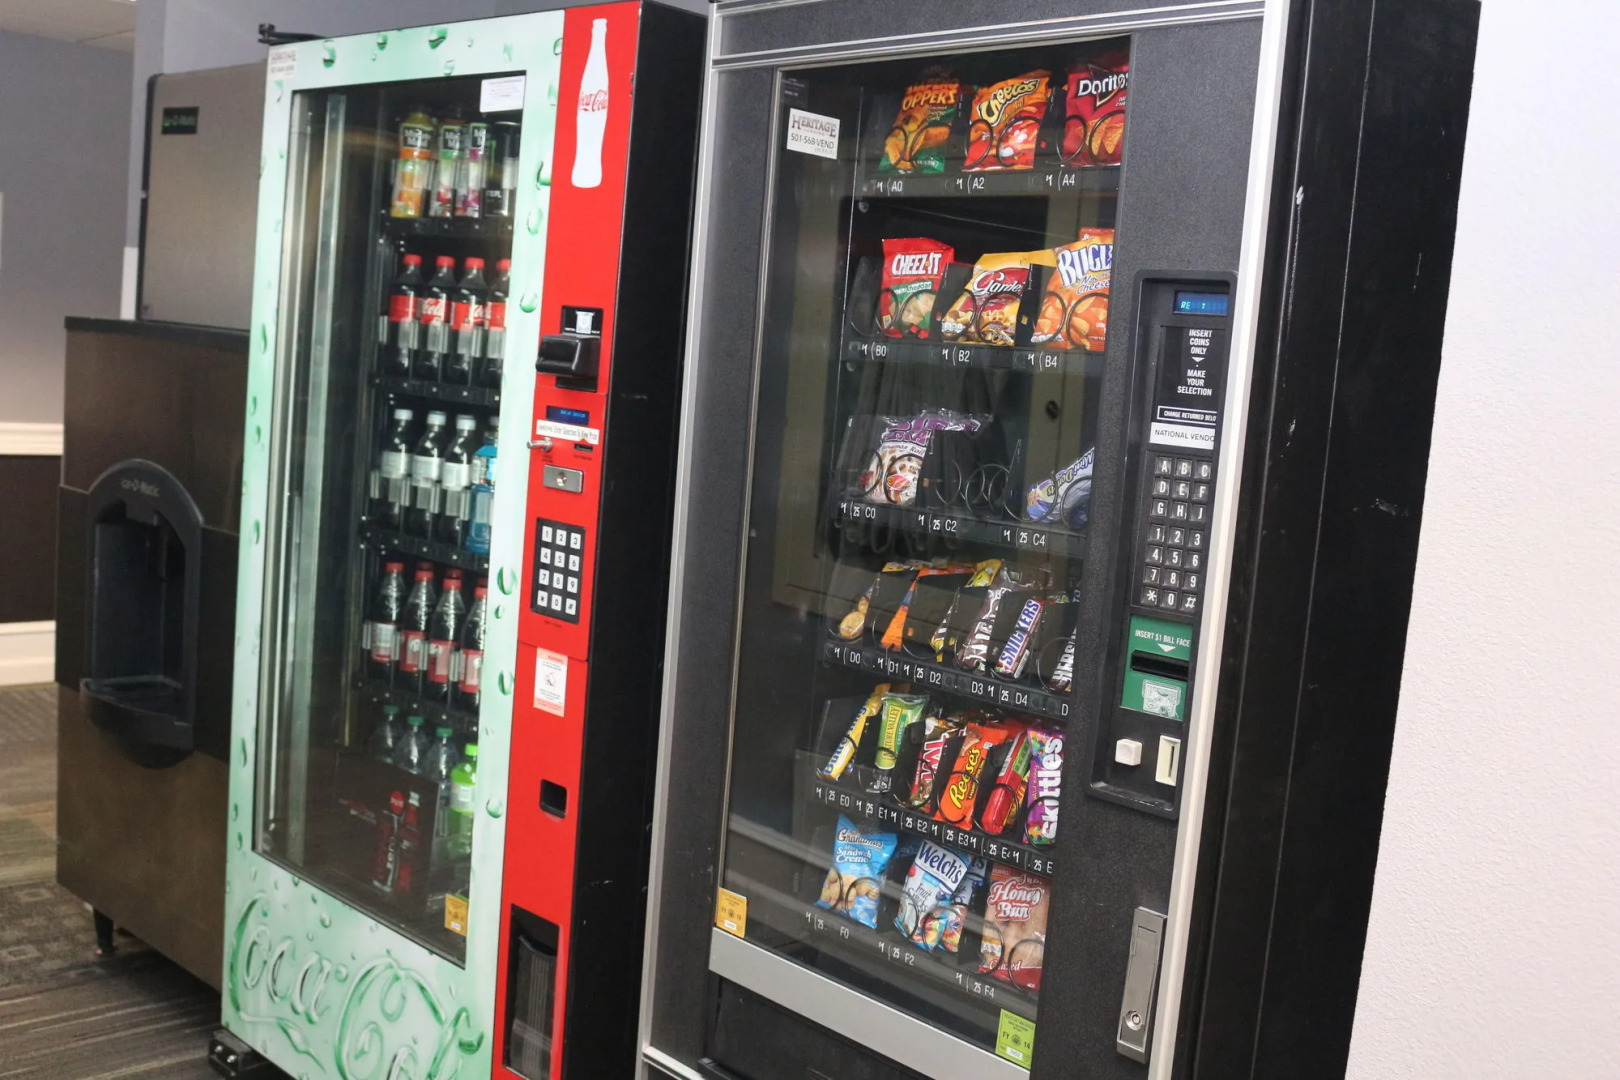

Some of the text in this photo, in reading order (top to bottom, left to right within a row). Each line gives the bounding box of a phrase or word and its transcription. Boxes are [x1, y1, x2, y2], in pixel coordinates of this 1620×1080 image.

[977, 78, 1039, 126] Cheetos
[791, 114, 837, 138] HERITAGE
[891, 180, 903, 192] A0
[972, 177, 985, 189] A2
[1062, 174, 1076, 186] A4
[973, 270, 1024, 296] Garde
[1189, 329, 1213, 338] INSERT
[1189, 337, 1210, 346] COINS
[875, 345, 887, 357] B0
[958, 350, 971, 362] B2
[1190, 346, 1207, 355] ONLY
[1045, 355, 1058, 368] B4
[1186, 369, 1206, 378] MAKE
[1187, 378, 1205, 387] YOUR
[1177, 386, 1213, 396] SELECTION
[1163, 410, 1181, 418] CHANGE
[1181, 411, 1204, 420] RETURNED
[1154, 429, 1189, 440] NATIONAL
[1161, 461, 1208, 477] A B C
[1046, 468, 1074, 496] Donts
[1159, 482, 1206, 498] D E F
[853, 506, 860, 517] 25
[865, 507, 876, 519] C0
[1157, 502, 1203, 519] G H J
[932, 518, 941, 530] 25
[945, 520, 957, 532] C2
[1019, 531, 1028, 544] 25
[1033, 533, 1046, 546] C4
[1156, 528, 1201, 546] 1 2 3
[1152, 549, 1199, 567] 4 5 6
[1150, 569, 1197, 587] 7 8 9
[1168, 593, 1196, 609] 0 #
[1000, 599, 1041, 667] SNICKERS
[1135, 629, 1191, 647] INSERT $1 BILL FACE
[850, 652, 861, 664] D0
[888, 661, 899, 673] D1
[916, 667, 924, 679] 25
[929, 672, 941, 684] D2
[971, 681, 983, 695] D3
[1001, 690, 1009, 701] 25
[1015, 694, 1028, 706] D4
[887, 707, 900, 731] VALLEY
[949, 747, 981, 809] Reese's
[828, 790, 836, 801] 25
[840, 795, 850, 808] E0
[866, 802, 874, 814] 25
[878, 806, 889, 820] E1
[905, 816, 913, 828] 25
[917, 819, 928, 833] E2
[946, 828, 954, 841] 25
[958, 832, 970, 846] E3
[989, 843, 997, 856] 25
[918, 841, 962, 884] Welch's
[1033, 857, 1042, 870] 25
[989, 879, 1042, 906] Honey
[997, 901, 1029, 919] Bun
[817, 918, 824, 930] 25
[840, 926, 849, 939] F0
[892, 947, 900, 959] 25
[904, 952, 915, 966] F2
[973, 981, 981, 993] 25
[985, 982, 995, 998] F4
